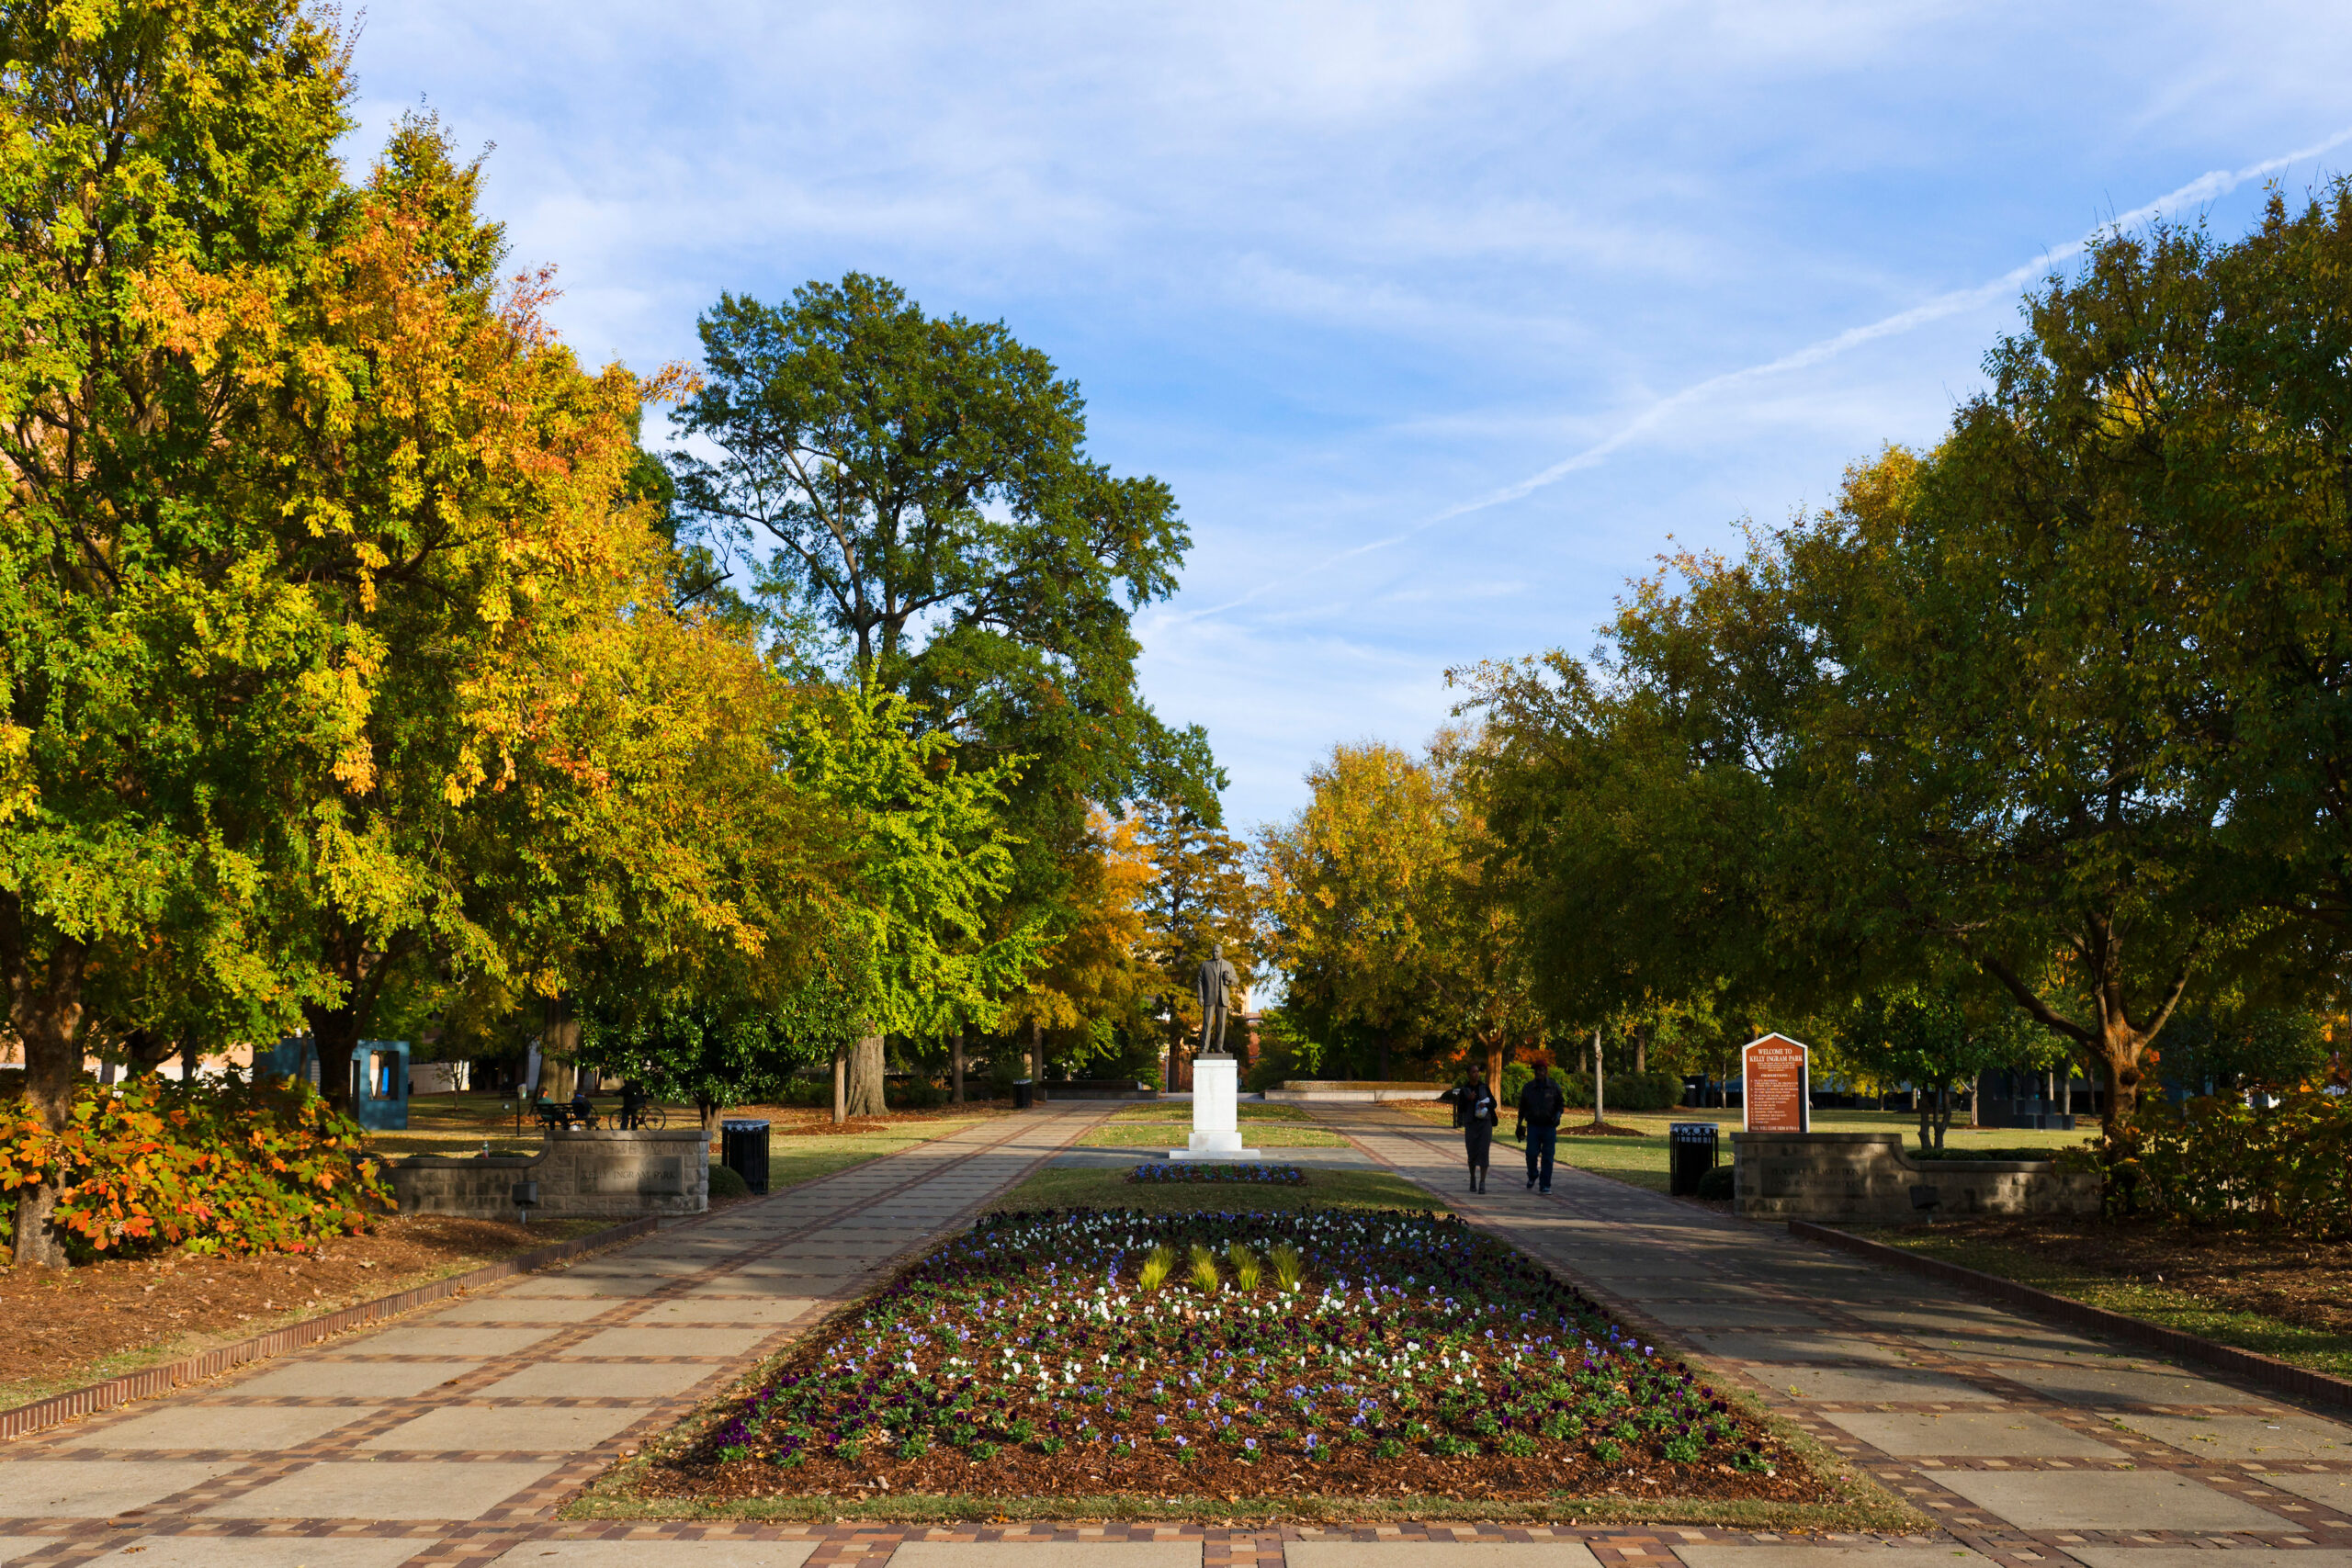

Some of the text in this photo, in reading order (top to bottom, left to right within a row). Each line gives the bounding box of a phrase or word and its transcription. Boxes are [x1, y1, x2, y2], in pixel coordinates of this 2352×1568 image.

[581, 1169, 676, 1179] KELLY INGRAM PARK
